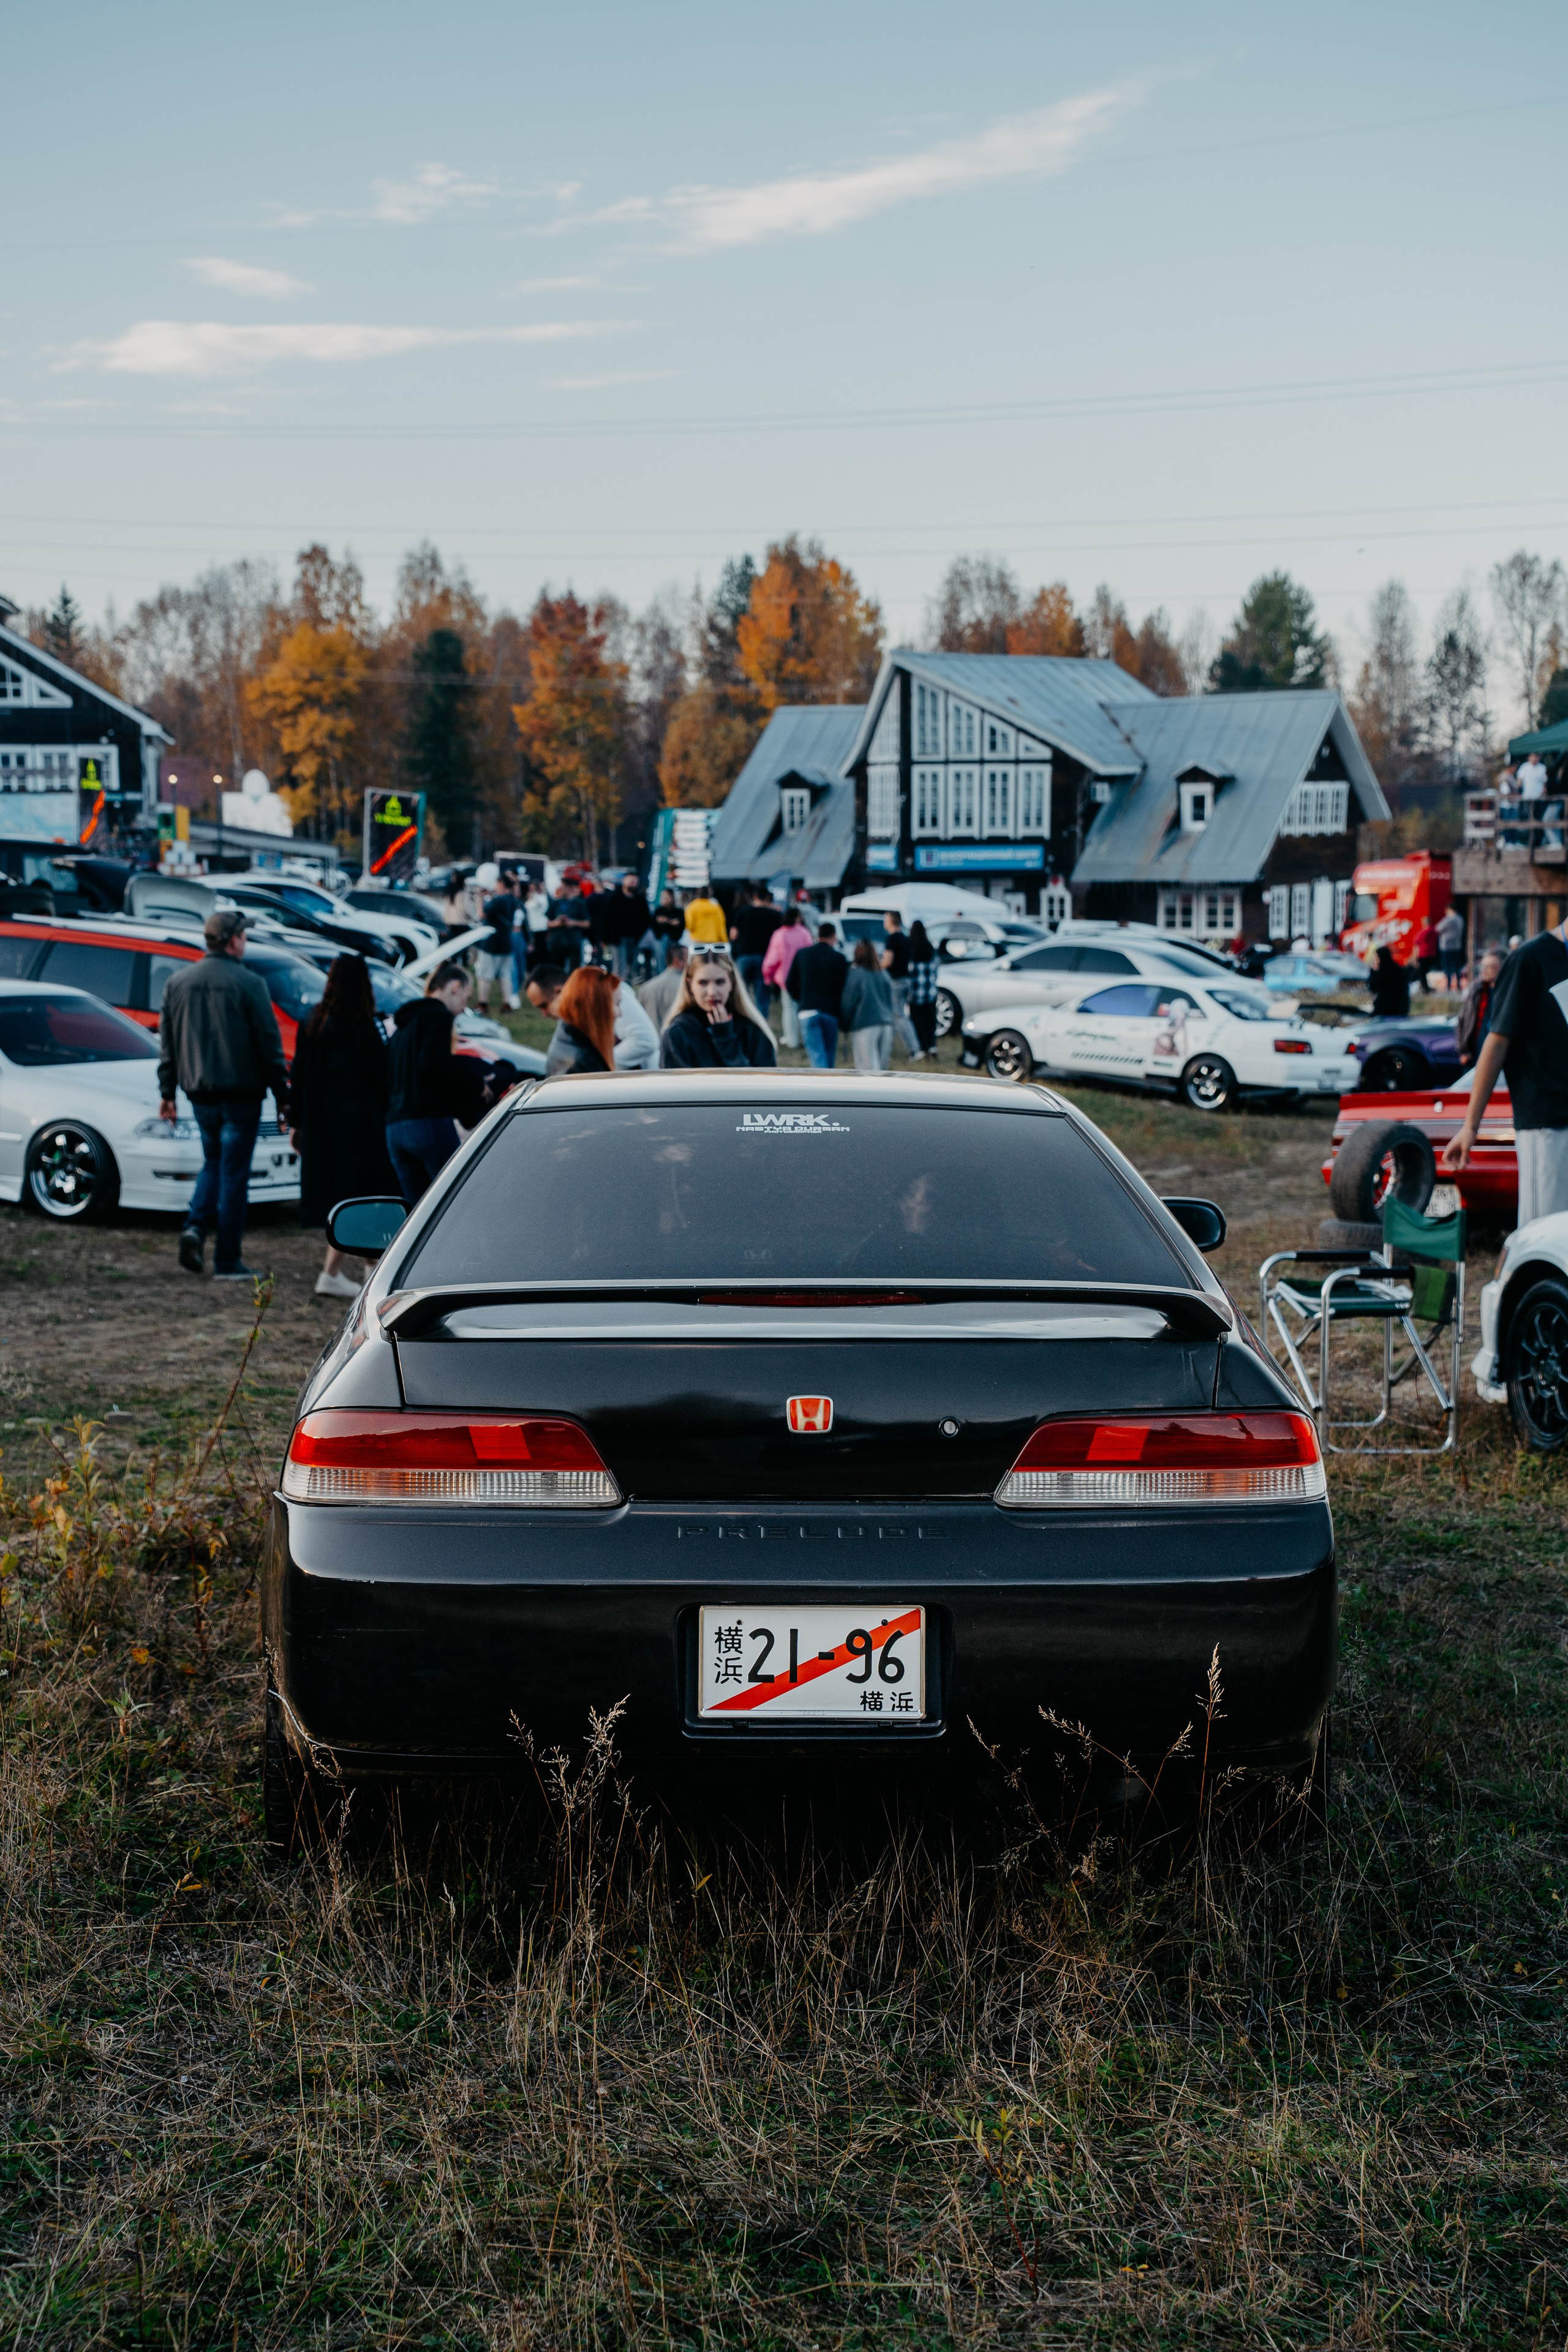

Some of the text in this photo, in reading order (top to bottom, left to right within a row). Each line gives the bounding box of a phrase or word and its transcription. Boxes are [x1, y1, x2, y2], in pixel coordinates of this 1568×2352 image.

[677, 1526, 949, 1539] PRELUDE
[714, 1626, 743, 1684] 横浜
[748, 1627, 905, 1684] 21-96
[859, 1691, 914, 1711] 横浜
